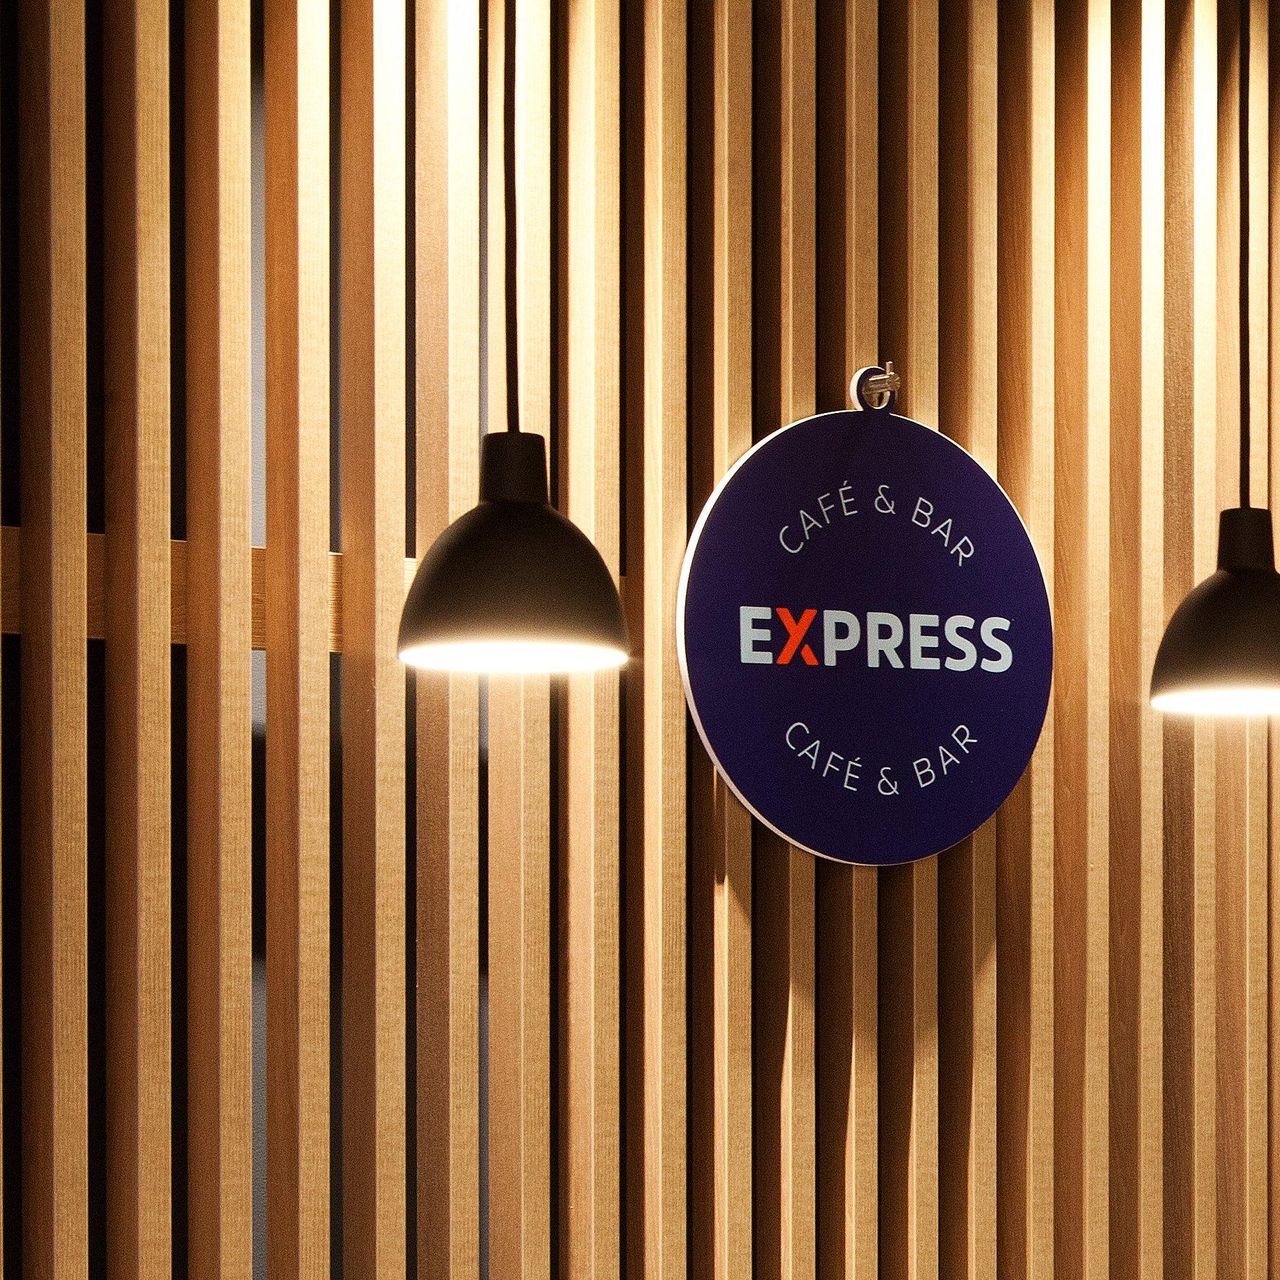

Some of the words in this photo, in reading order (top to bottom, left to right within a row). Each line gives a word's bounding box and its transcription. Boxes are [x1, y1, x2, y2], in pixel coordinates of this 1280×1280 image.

[778, 480, 859, 555] CAFÉ
[874, 484, 897, 515] &
[911, 496, 976, 568] BAR
[739, 605, 1014, 674] EXPRESS
[785, 721, 862, 793] CAFÉ
[877, 766, 901, 796] &
[912, 724, 979, 789] BAR
